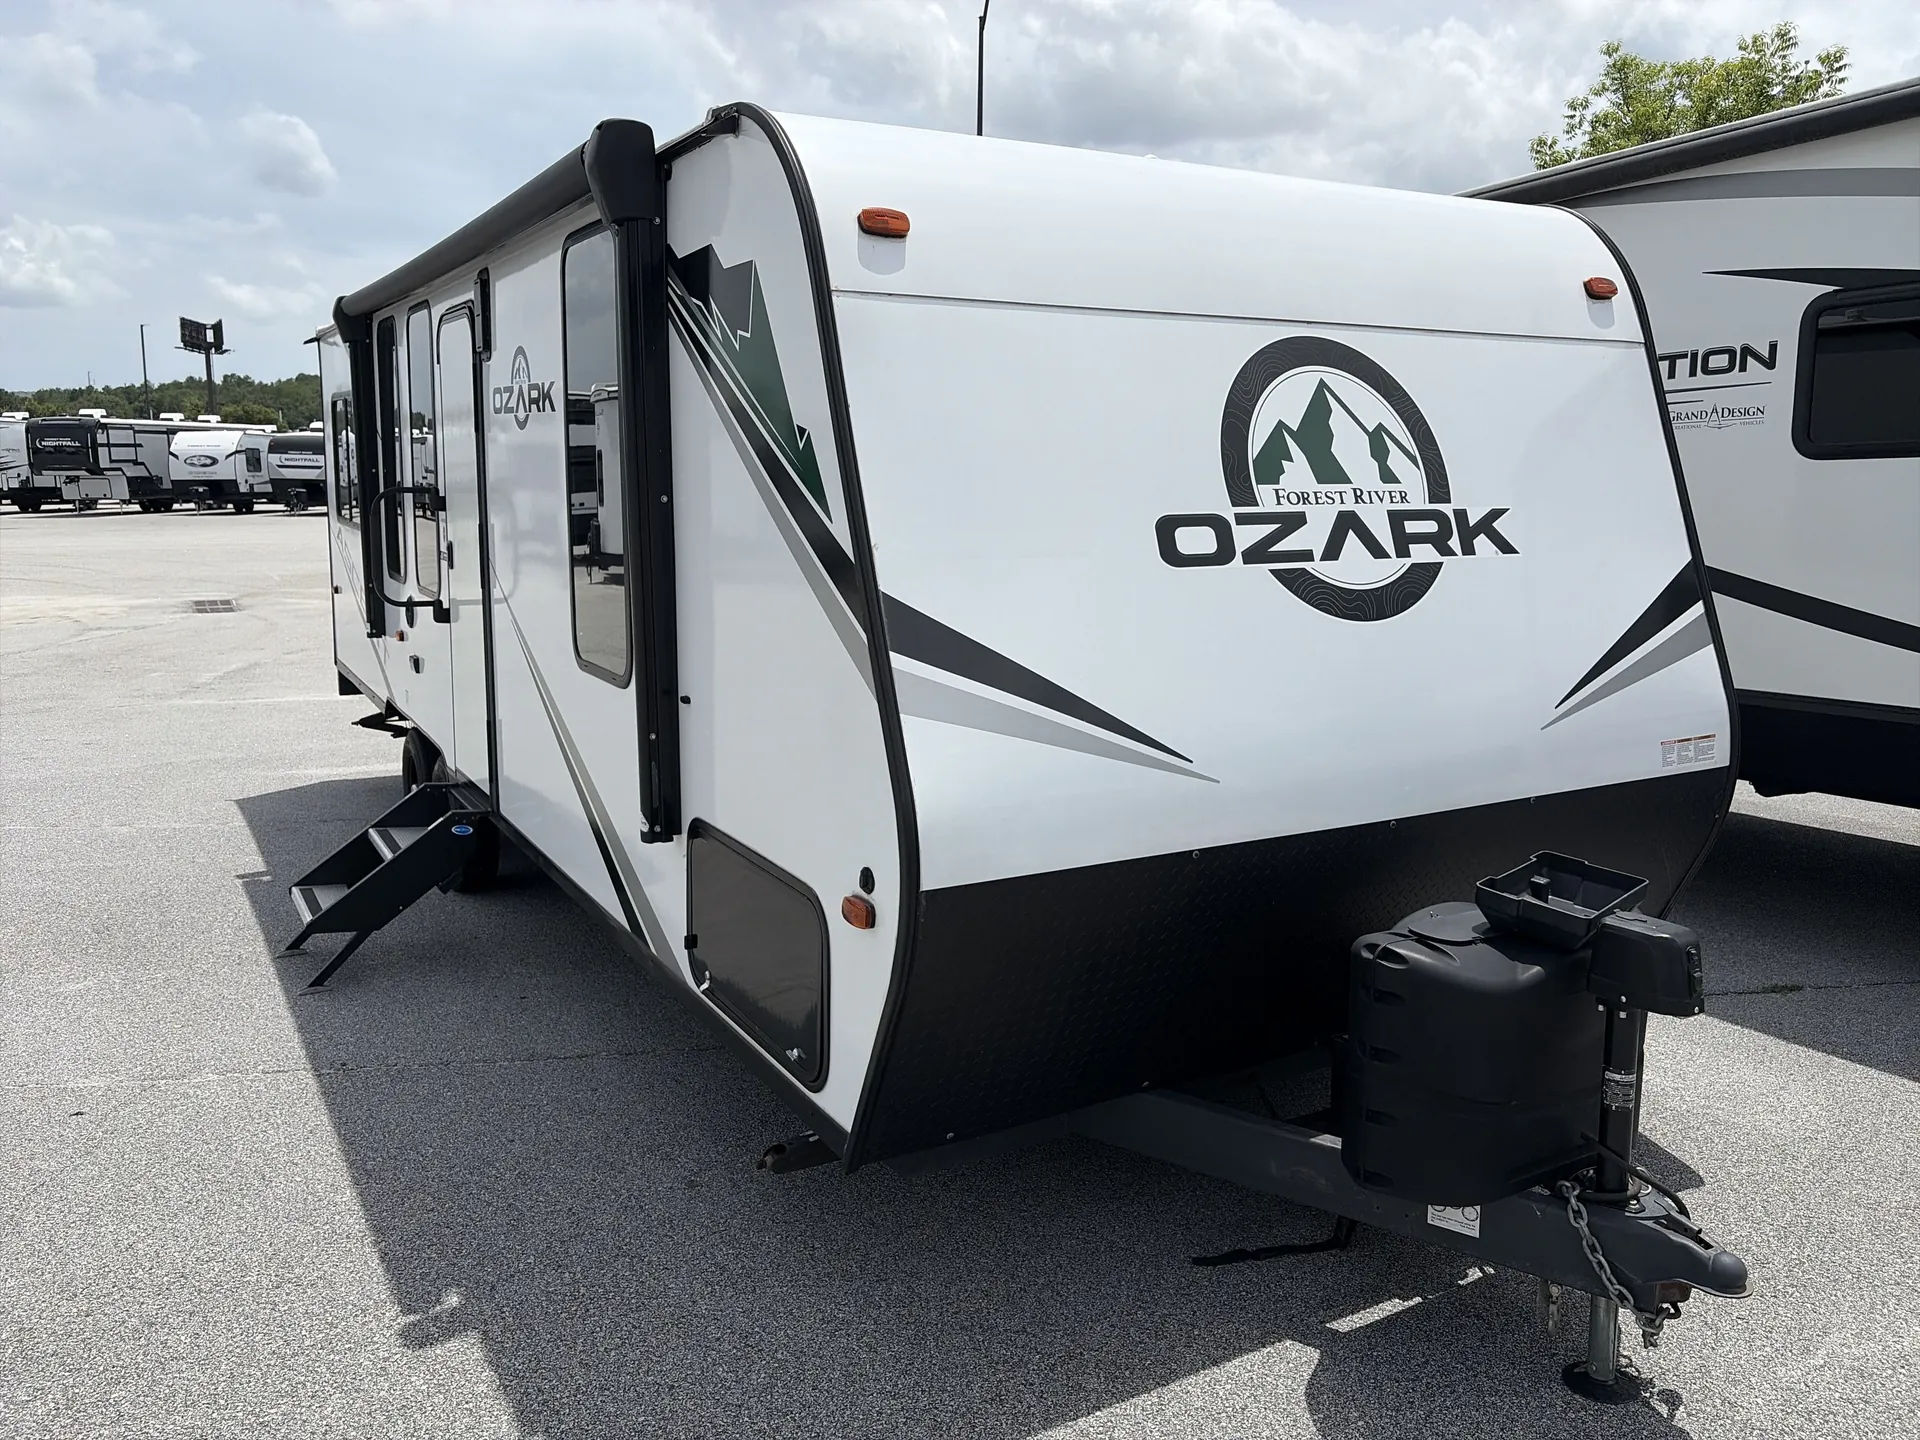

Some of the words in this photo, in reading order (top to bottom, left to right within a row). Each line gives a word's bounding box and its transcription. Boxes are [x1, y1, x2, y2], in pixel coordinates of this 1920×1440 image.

[493, 381, 556, 414] OZARK
[1669, 409, 1708, 422] GRAND
[1721, 405, 1765, 419] DESIGN
[1739, 419, 1765, 427] VEHICLES
[1272, 488, 1347, 506] FOREST
[1350, 487, 1411, 505] RIVER
[1155, 508, 1520, 568] OZARK
